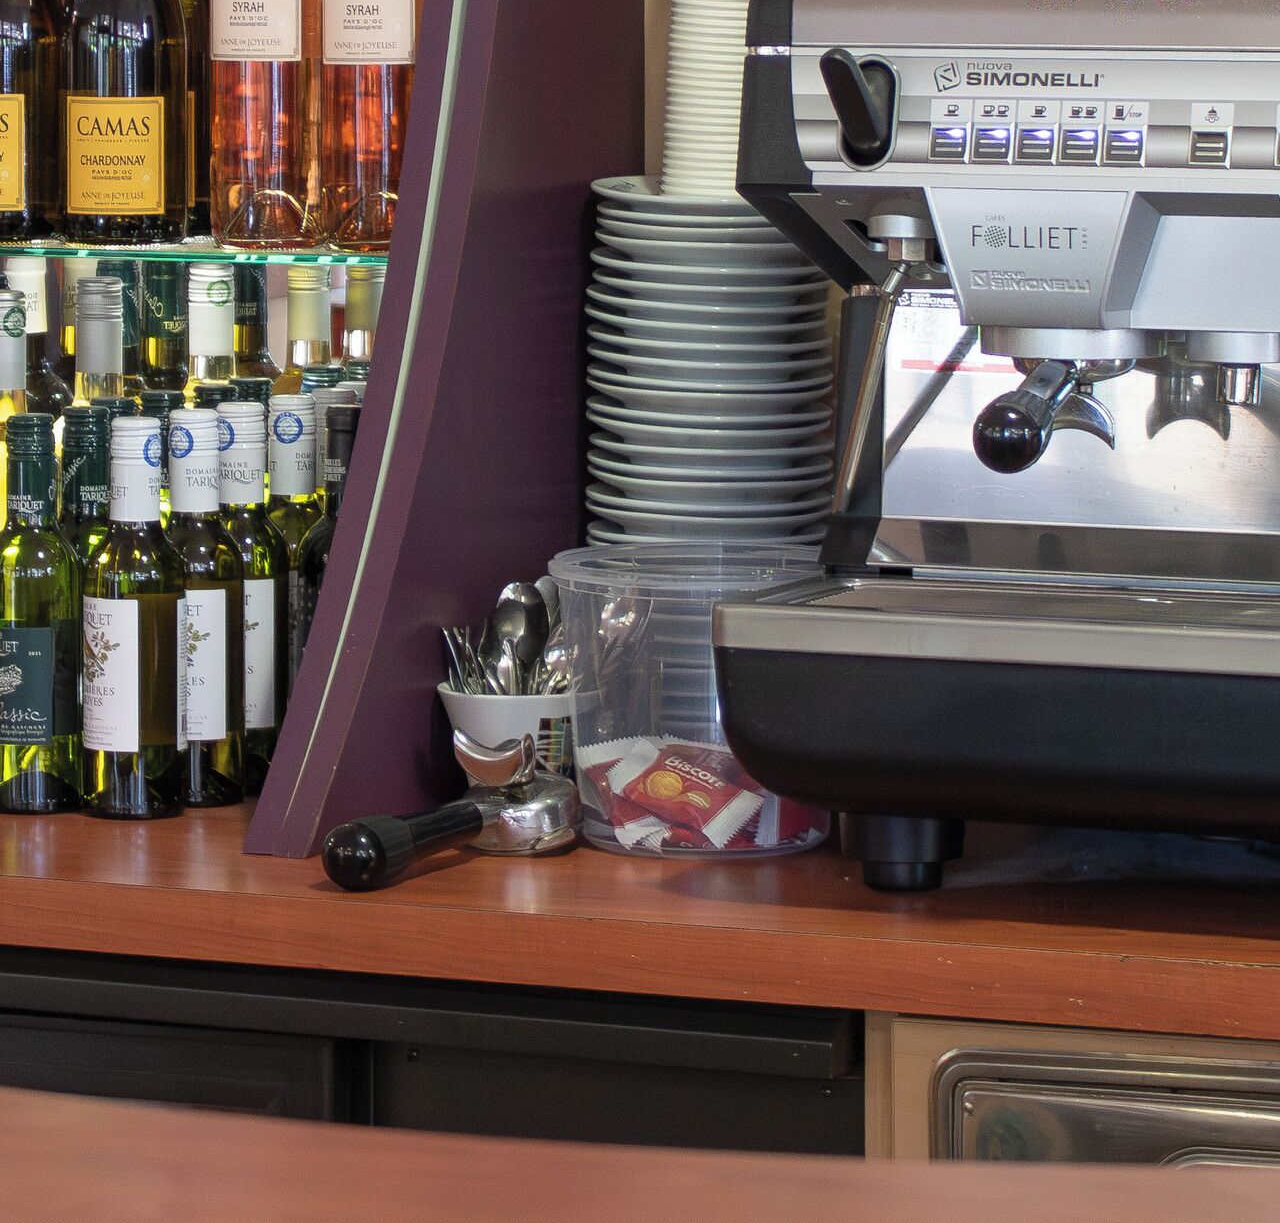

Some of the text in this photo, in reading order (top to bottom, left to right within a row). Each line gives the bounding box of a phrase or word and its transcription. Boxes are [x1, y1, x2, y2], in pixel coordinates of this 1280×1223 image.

[232, 1, 265, 13] SYRAH
[346, 4, 379, 16] SYRAH
[246, 37, 282, 47] JOYEUSE
[361, 41, 398, 51] JOYEUSE
[966, 62, 1013, 71] nuova
[965, 72, 1100, 88] SIMONELLI
[77, 115, 151, 137] CAMAS
[80, 154, 146, 166] CHARDONNAY
[111, 191, 146, 201] JOYEUSE
[990, 278, 1091, 293] SIMONELLI
